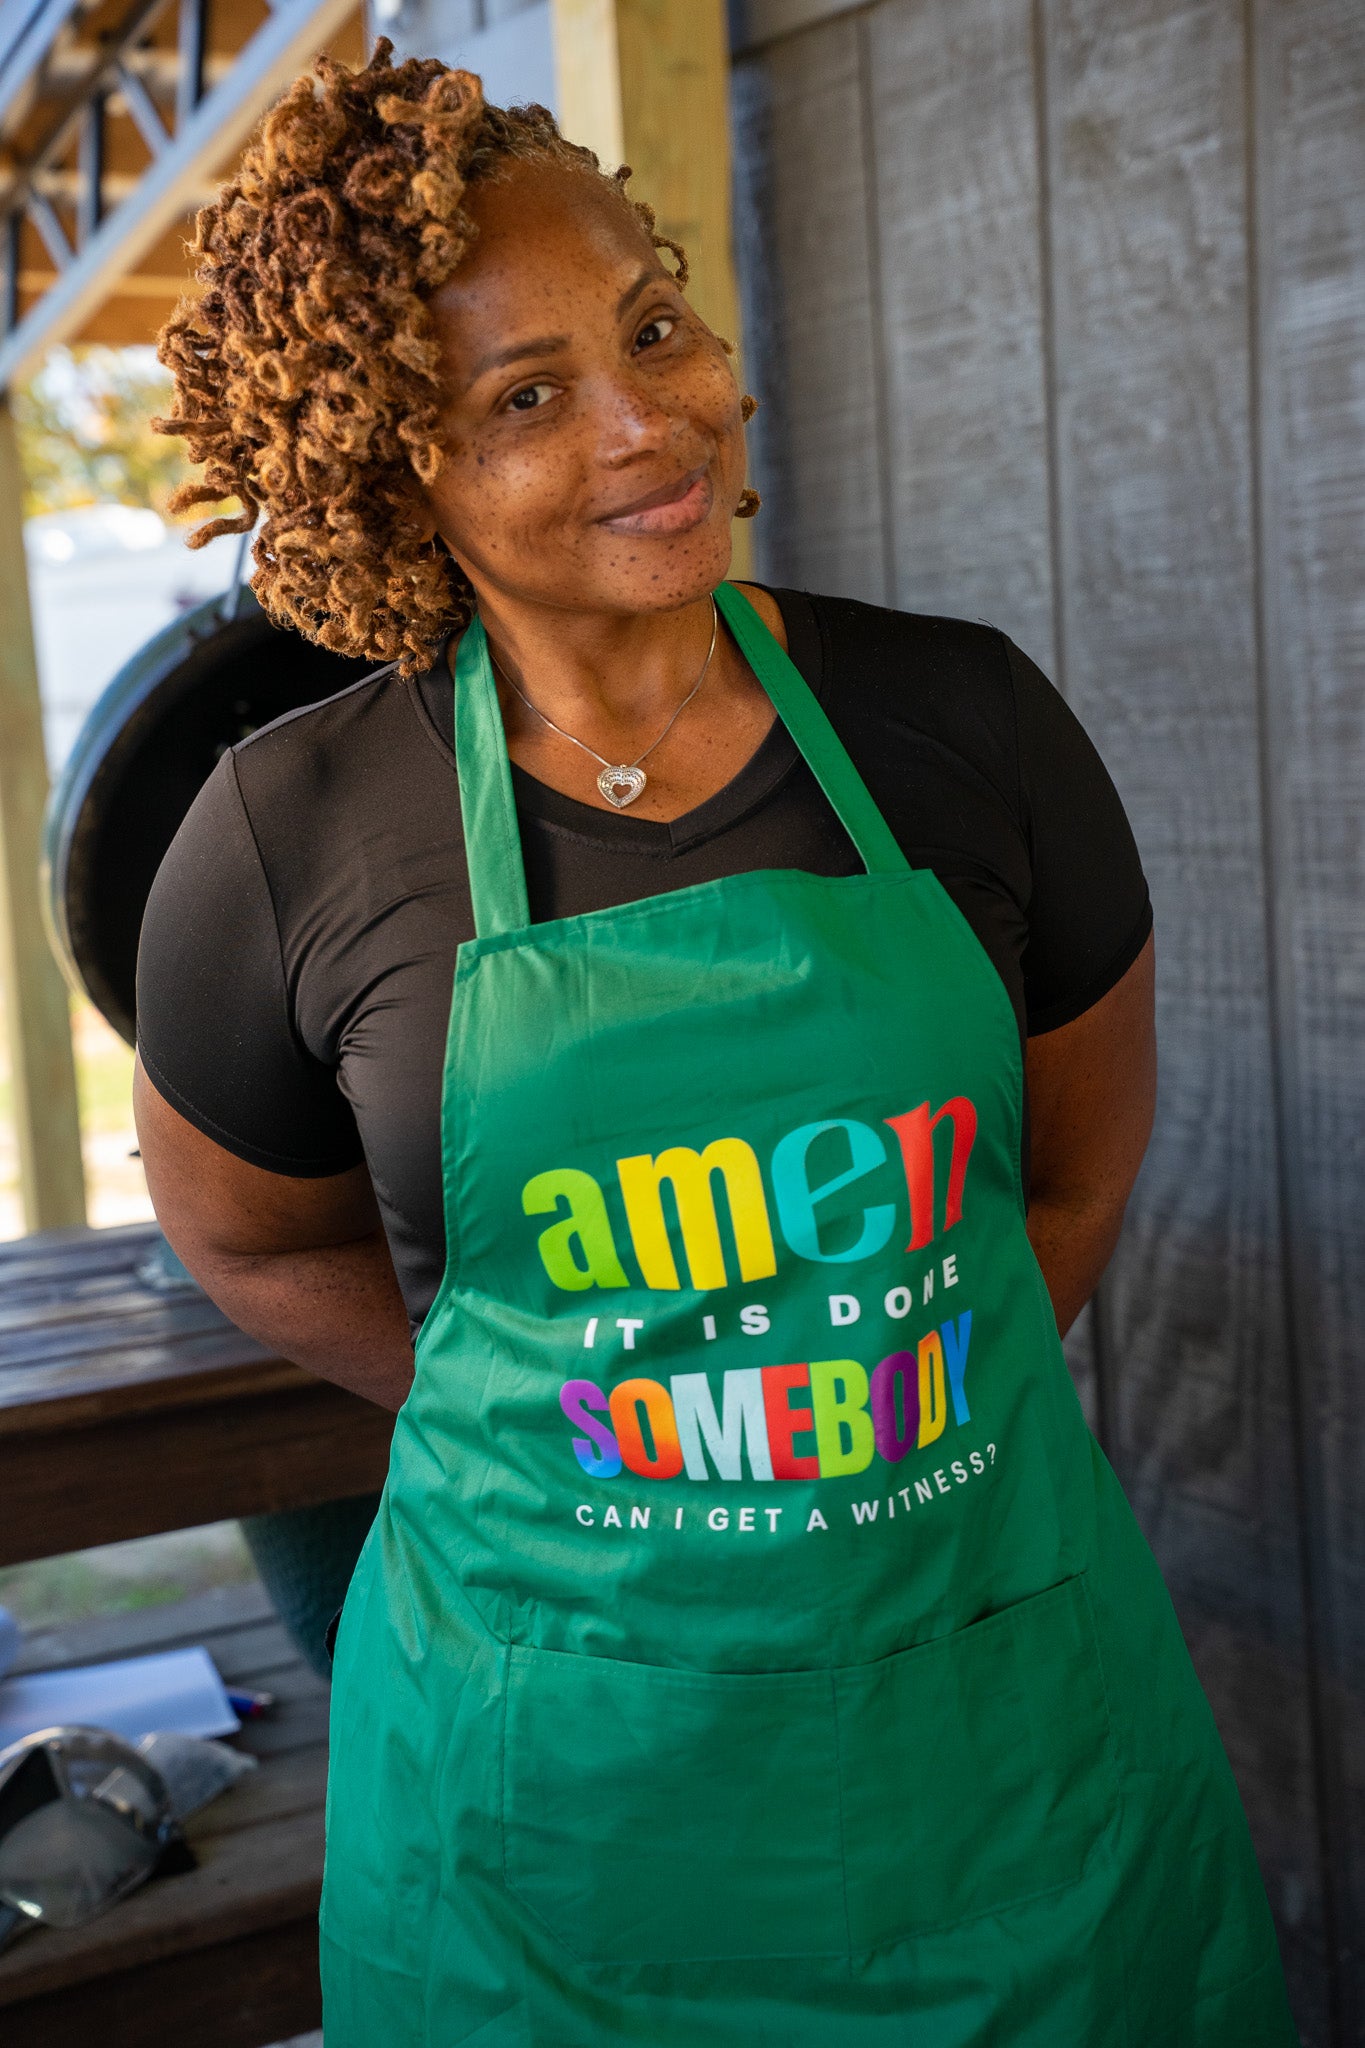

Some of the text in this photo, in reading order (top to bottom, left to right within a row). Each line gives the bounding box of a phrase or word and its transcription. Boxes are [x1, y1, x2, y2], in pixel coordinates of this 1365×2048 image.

[521, 1096, 978, 1291] amen
[584, 1254, 959, 1350] IT IS DONE
[559, 1309, 973, 1481] SOMEBODY
[575, 1443, 997, 1532] CAN I GET A WITNESS?
